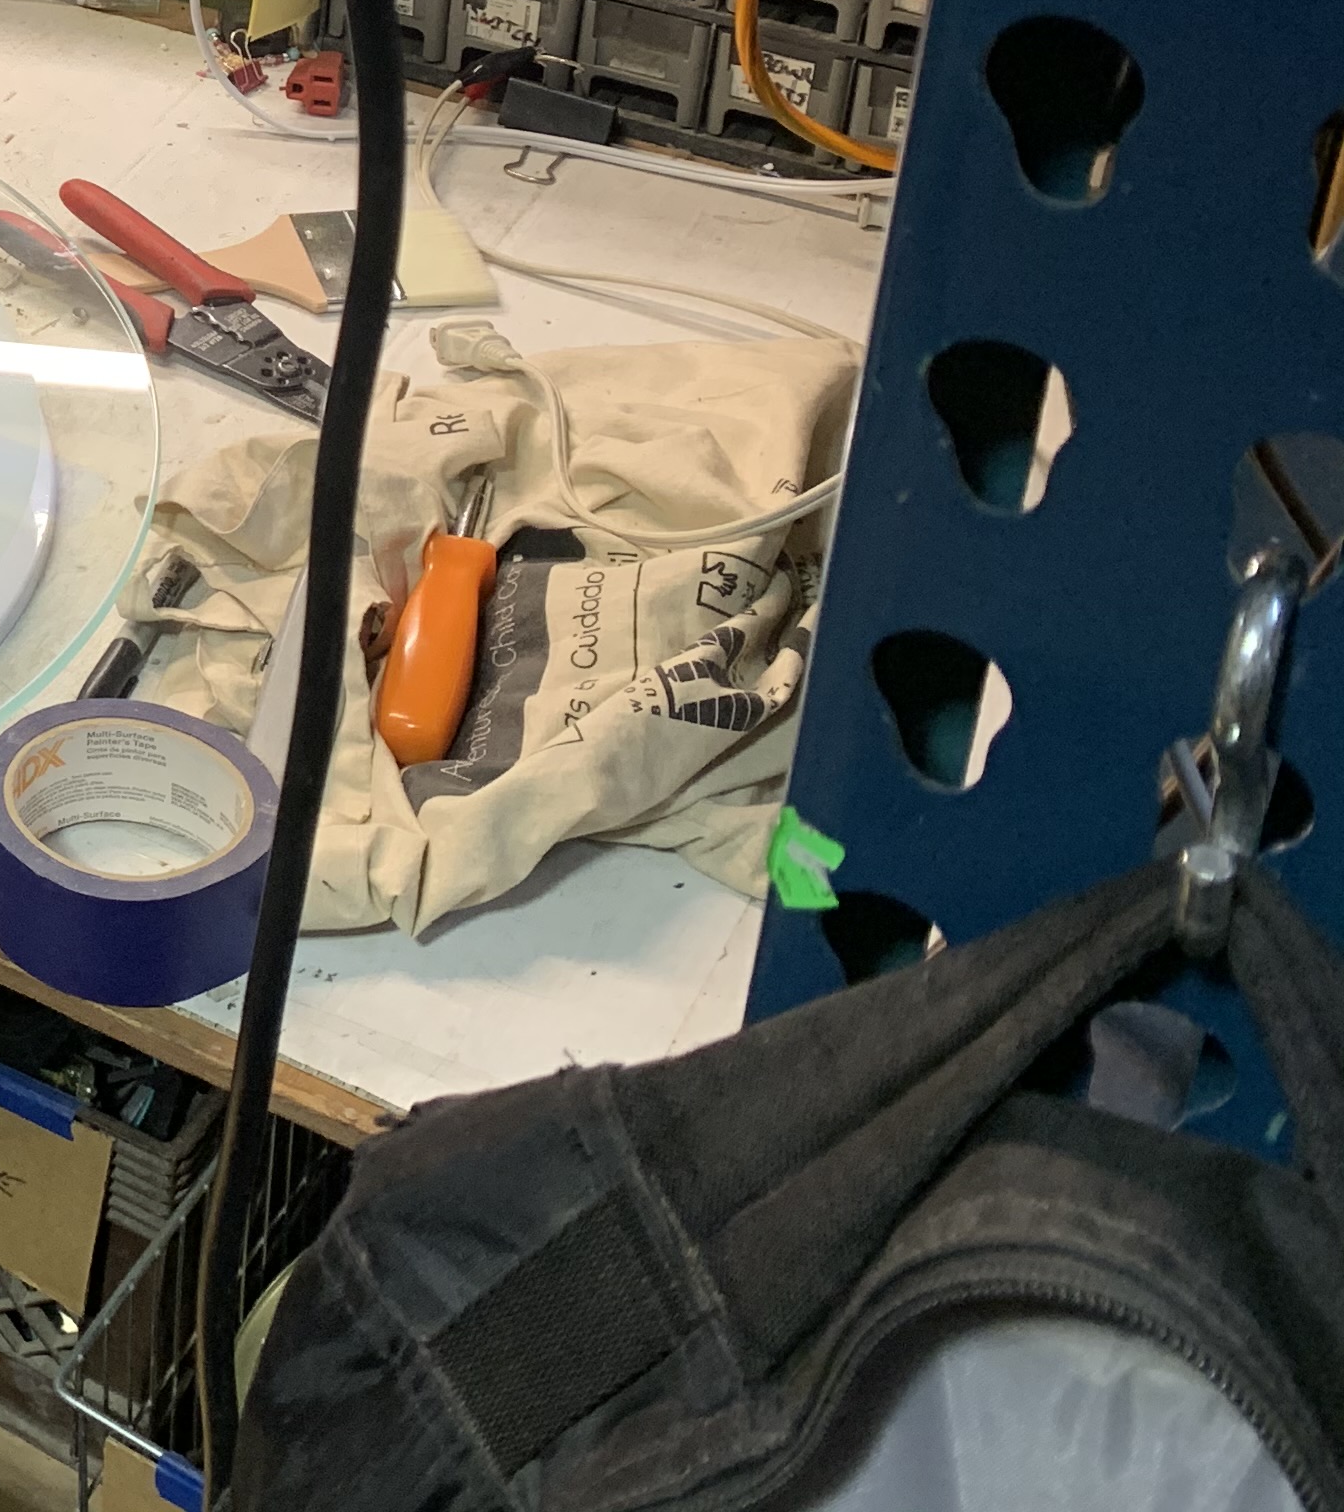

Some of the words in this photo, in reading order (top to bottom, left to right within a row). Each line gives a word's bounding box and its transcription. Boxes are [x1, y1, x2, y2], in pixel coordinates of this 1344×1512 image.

[569, 570, 606, 670] Cuidado
[491, 606, 518, 664] Child
[86, 730, 156, 742] Multi-Surface
[86, 738, 131, 747] Painter's
[133, 740, 157, 750] Tape
[86, 752, 132, 761] superficies
[133, 755, 167, 767] diversas
[57, 811, 122, 827] Multi-Surface
